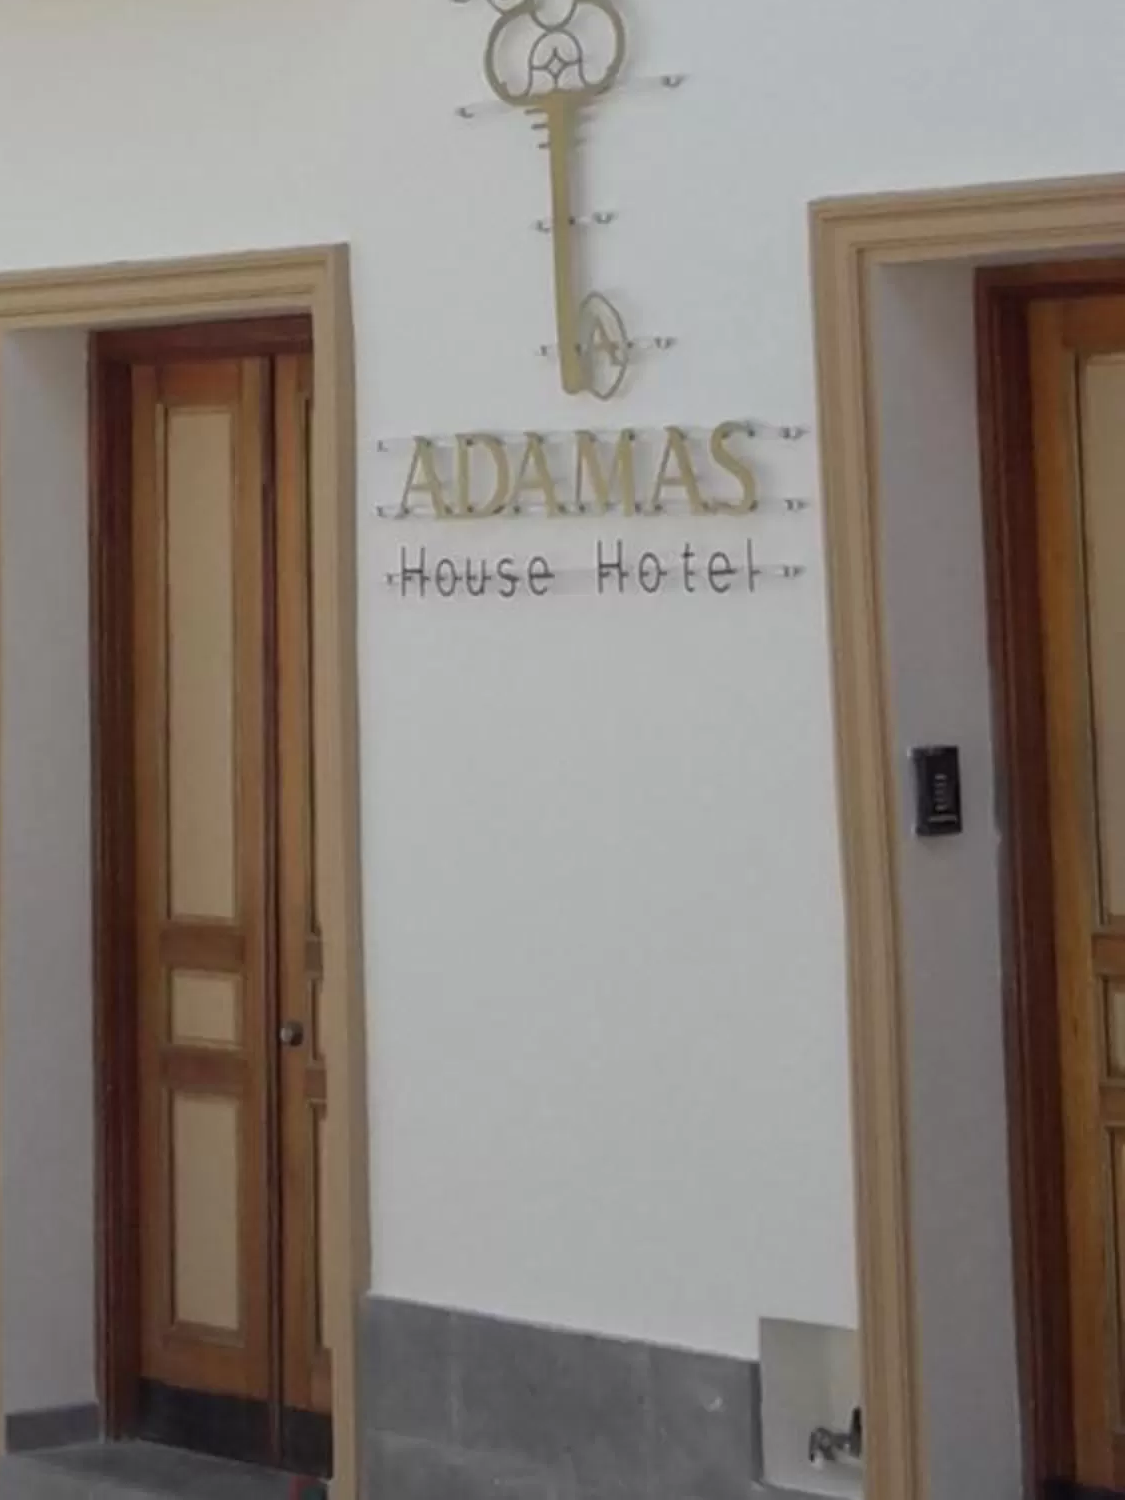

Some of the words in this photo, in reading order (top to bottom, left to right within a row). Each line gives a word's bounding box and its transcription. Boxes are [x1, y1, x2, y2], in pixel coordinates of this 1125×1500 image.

[396, 420, 759, 519] ADAMAS
[399, 546, 555, 598] House
[597, 538, 758, 595] Hotel
